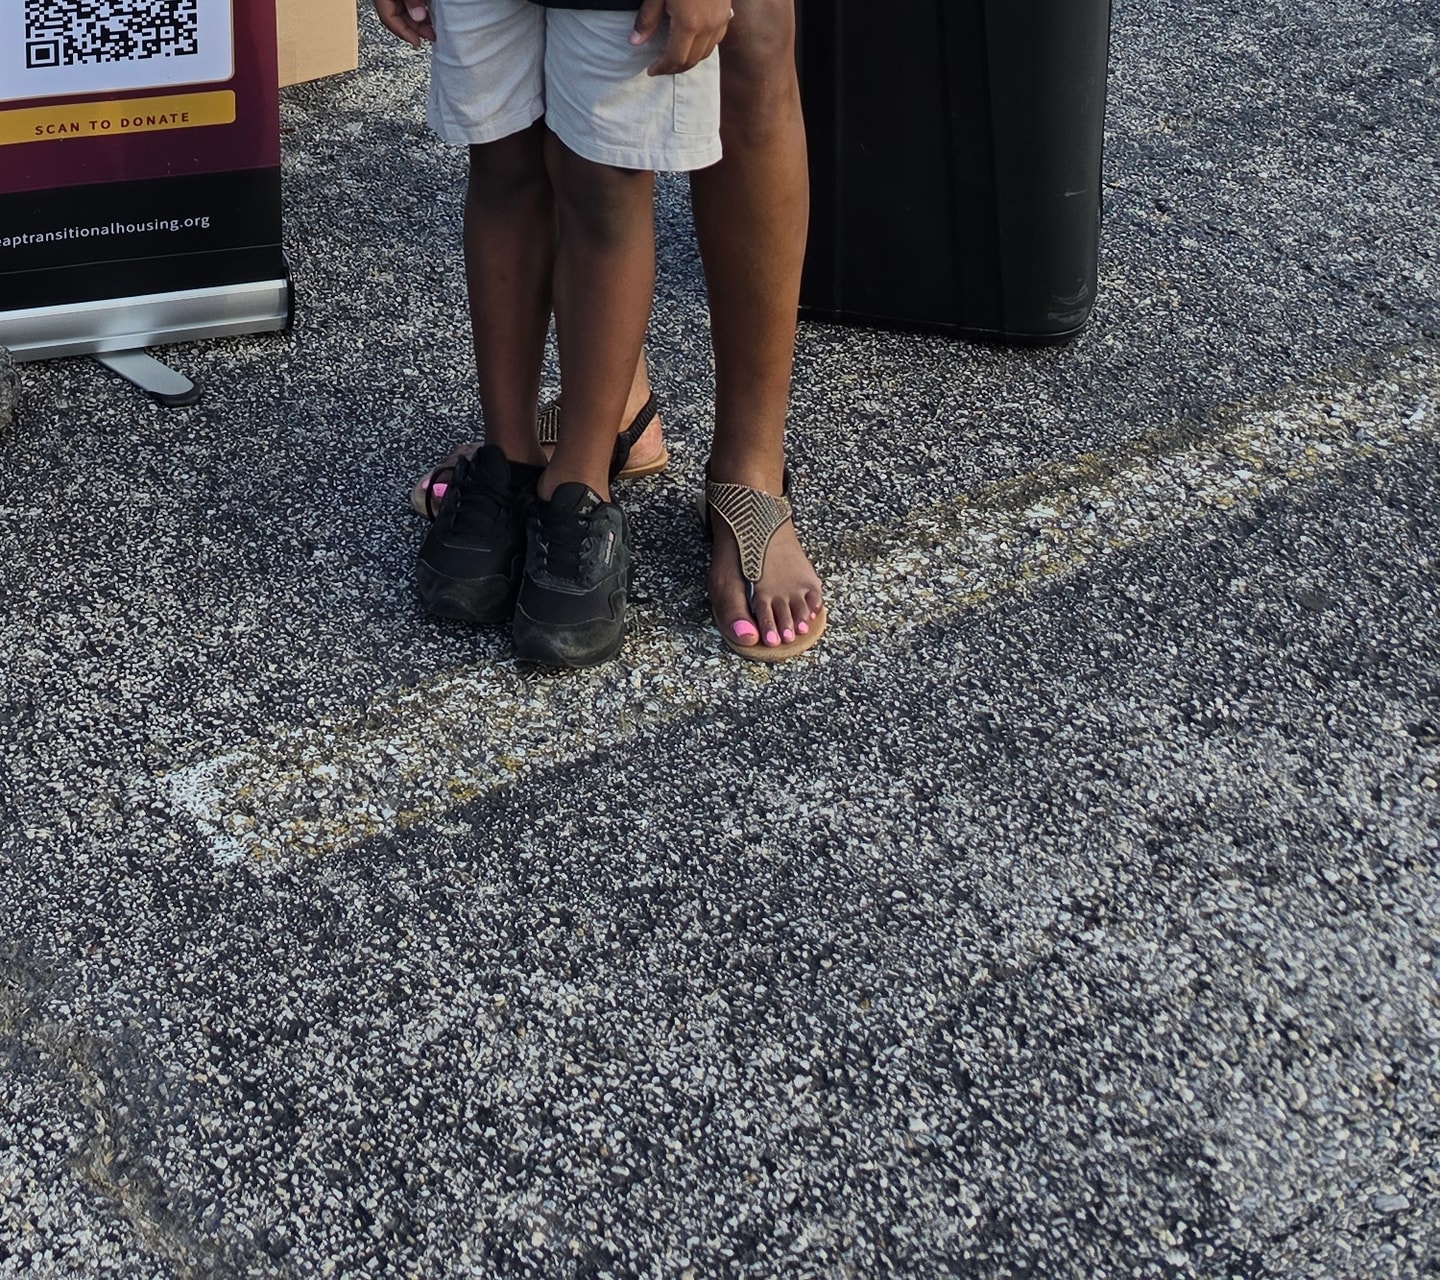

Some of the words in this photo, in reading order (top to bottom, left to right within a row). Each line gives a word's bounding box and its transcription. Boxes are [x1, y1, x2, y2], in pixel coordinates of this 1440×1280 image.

[34, 123, 81, 138] SCAN
[88, 119, 111, 132] TO
[118, 111, 192, 129] DONATE
